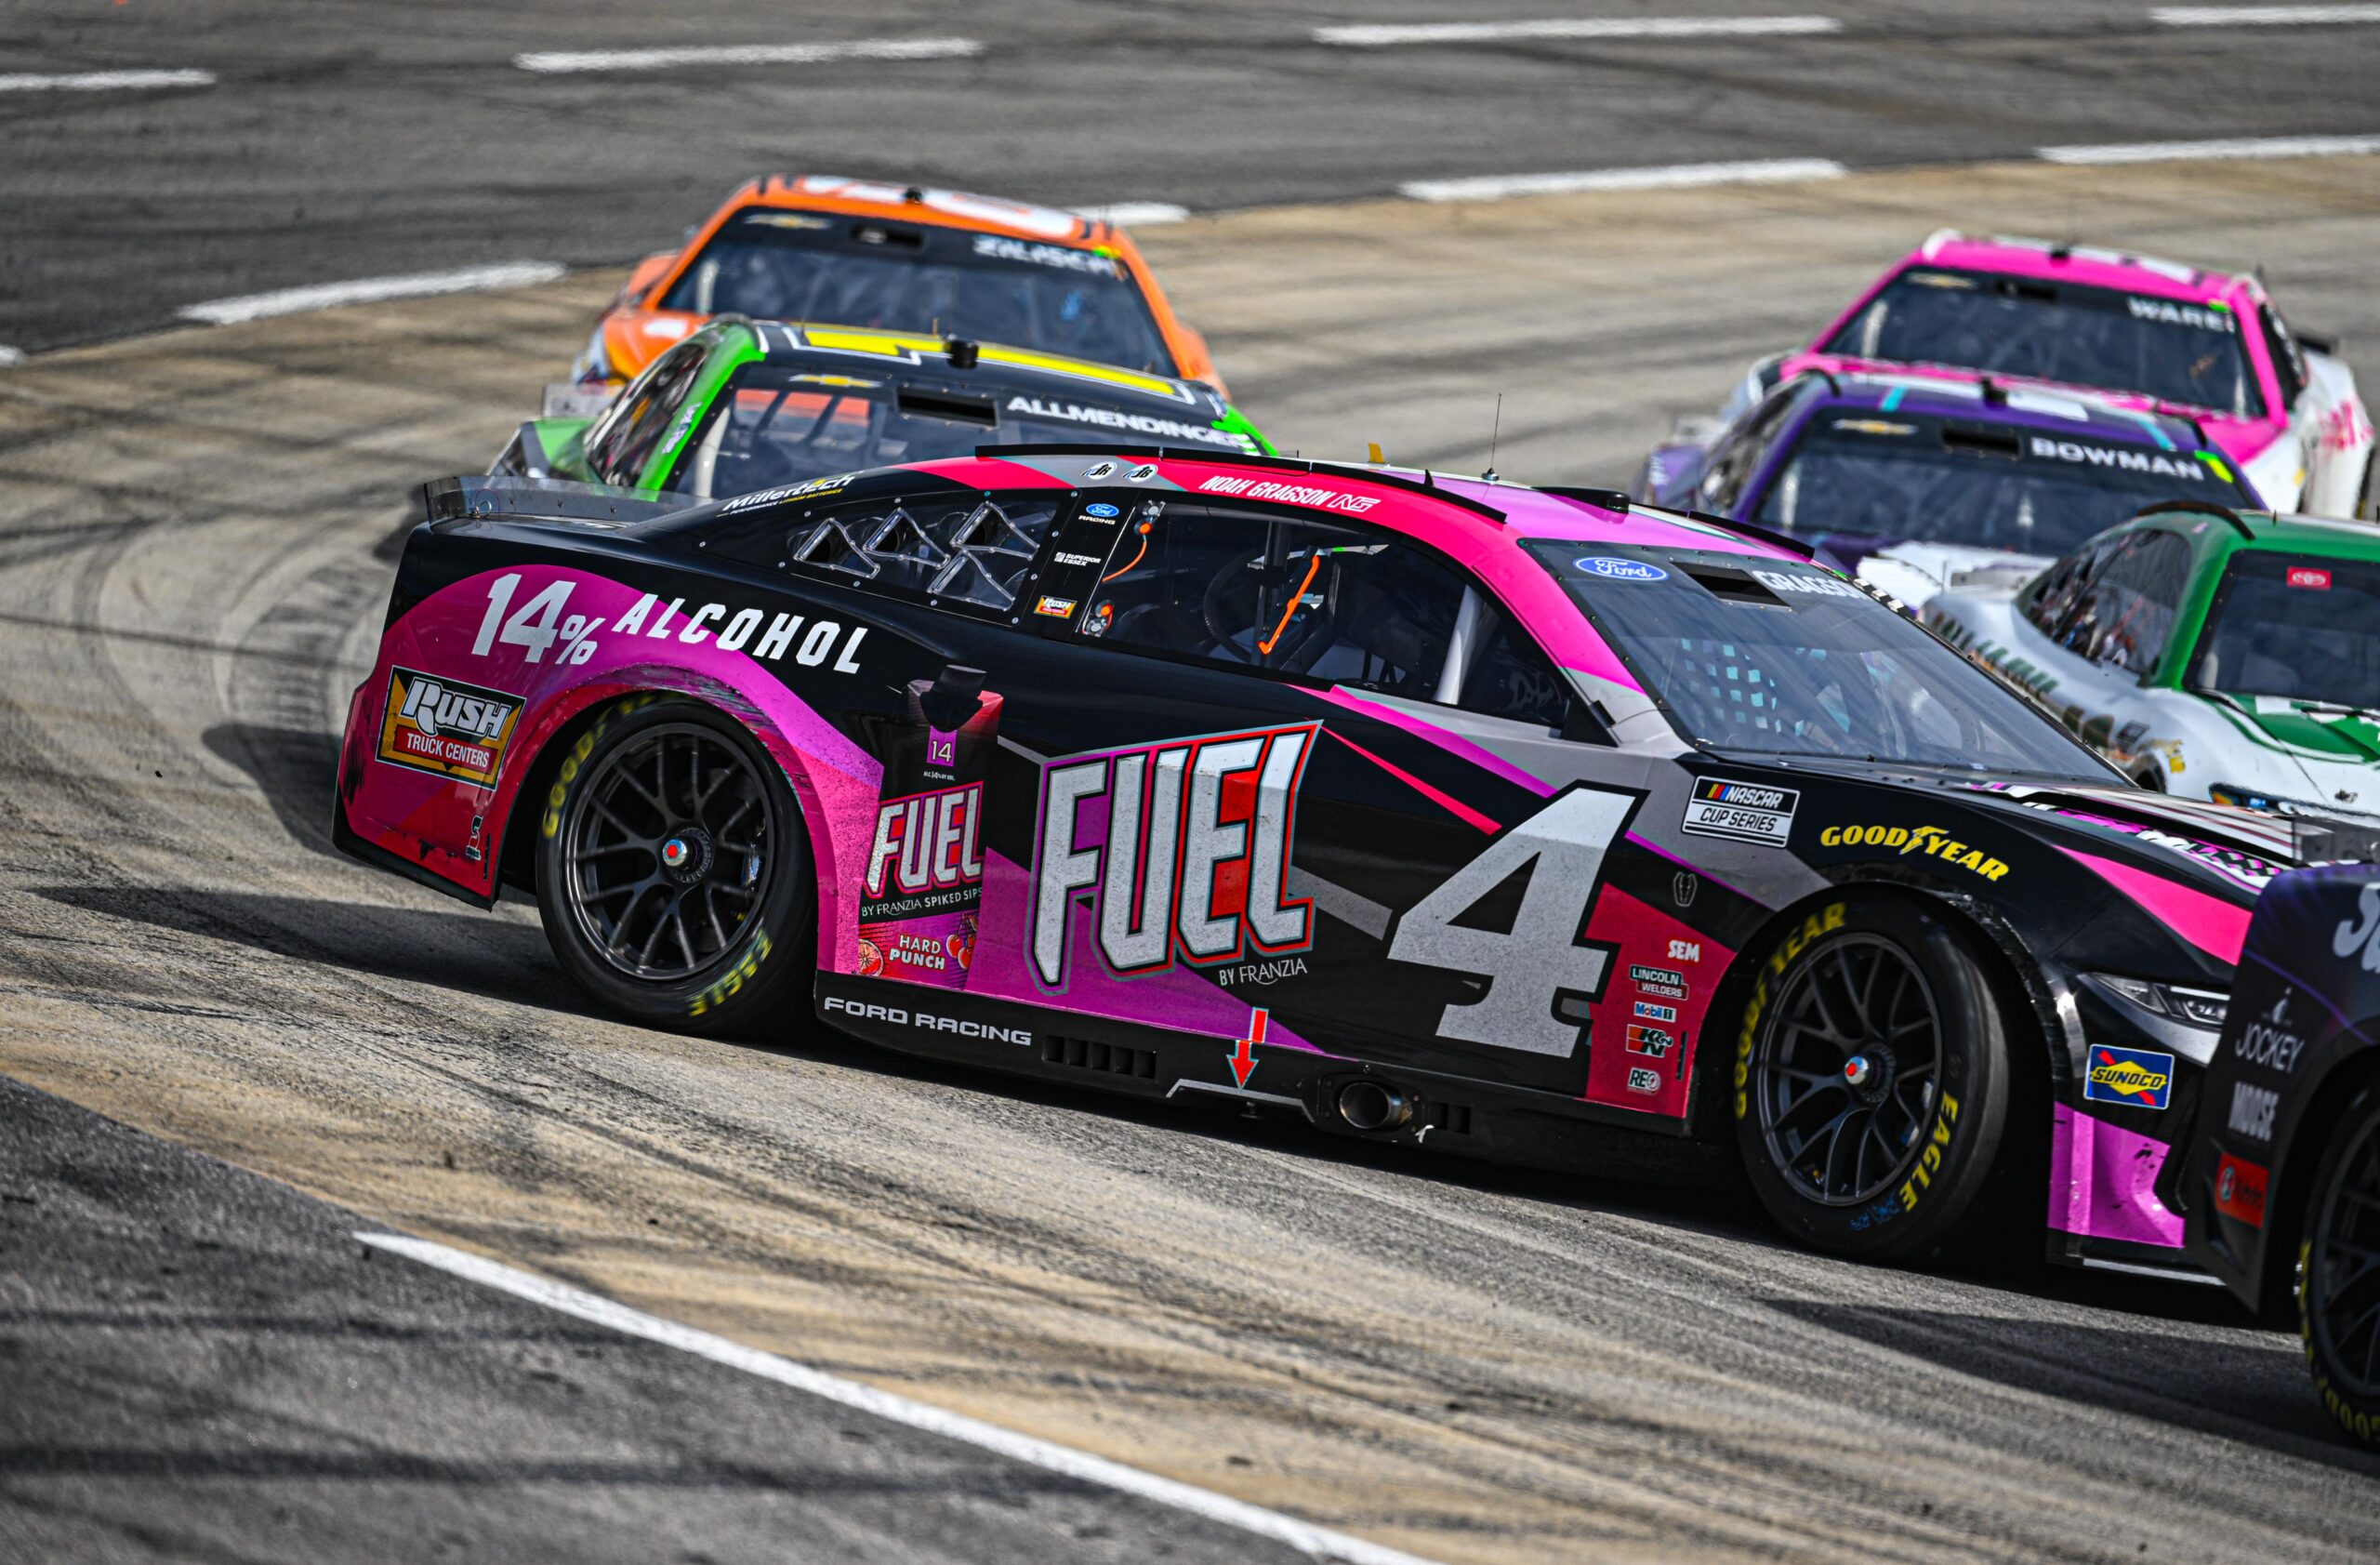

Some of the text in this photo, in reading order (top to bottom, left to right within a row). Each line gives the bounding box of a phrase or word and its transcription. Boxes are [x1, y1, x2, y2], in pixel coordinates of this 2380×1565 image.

[2127, 297, 2226, 333] WARE
[2030, 436, 2204, 482] BOWMAN
[721, 474, 855, 511] Millertech
[1198, 475, 1256, 494] NOAH
[1247, 481, 1337, 506] GRAGSON
[1078, 514, 1117, 525] RACING
[1065, 553, 1102, 564] SUPERIOR
[1593, 558, 1652, 578] Ford
[469, 573, 868, 674] 14% ALCOHOL
[406, 732, 490, 768] TRUCK CENTERS
[931, 740, 952, 763] 14
[1725, 786, 1783, 810] NASCAR
[1700, 807, 1778, 832] CUP SERIES
[865, 783, 984, 896] FUEL
[1030, 726, 1314, 990] FUEL
[861, 888, 983, 917] BY FRANZIA SPIKED SIPS
[1386, 787, 1637, 1059] 4
[899, 934, 942, 954] HARD
[1667, 939, 1700, 962] SEM
[889, 948, 945, 971] PUNCH
[1218, 958, 1309, 988] BY FRANZIA
[1632, 967, 1680, 986] LINCOLN
[1641, 981, 1683, 998] WELDERS
[824, 997, 1033, 1047] FORD RACING
[1635, 1002, 1662, 1018] Mobil
[2235, 1023, 2305, 1073] JOCKEY
[2089, 1064, 2167, 1094] SUNOCO
[2228, 1081, 2281, 1142] MOOSE
[1899, 1091, 1960, 1212] EAGLE
